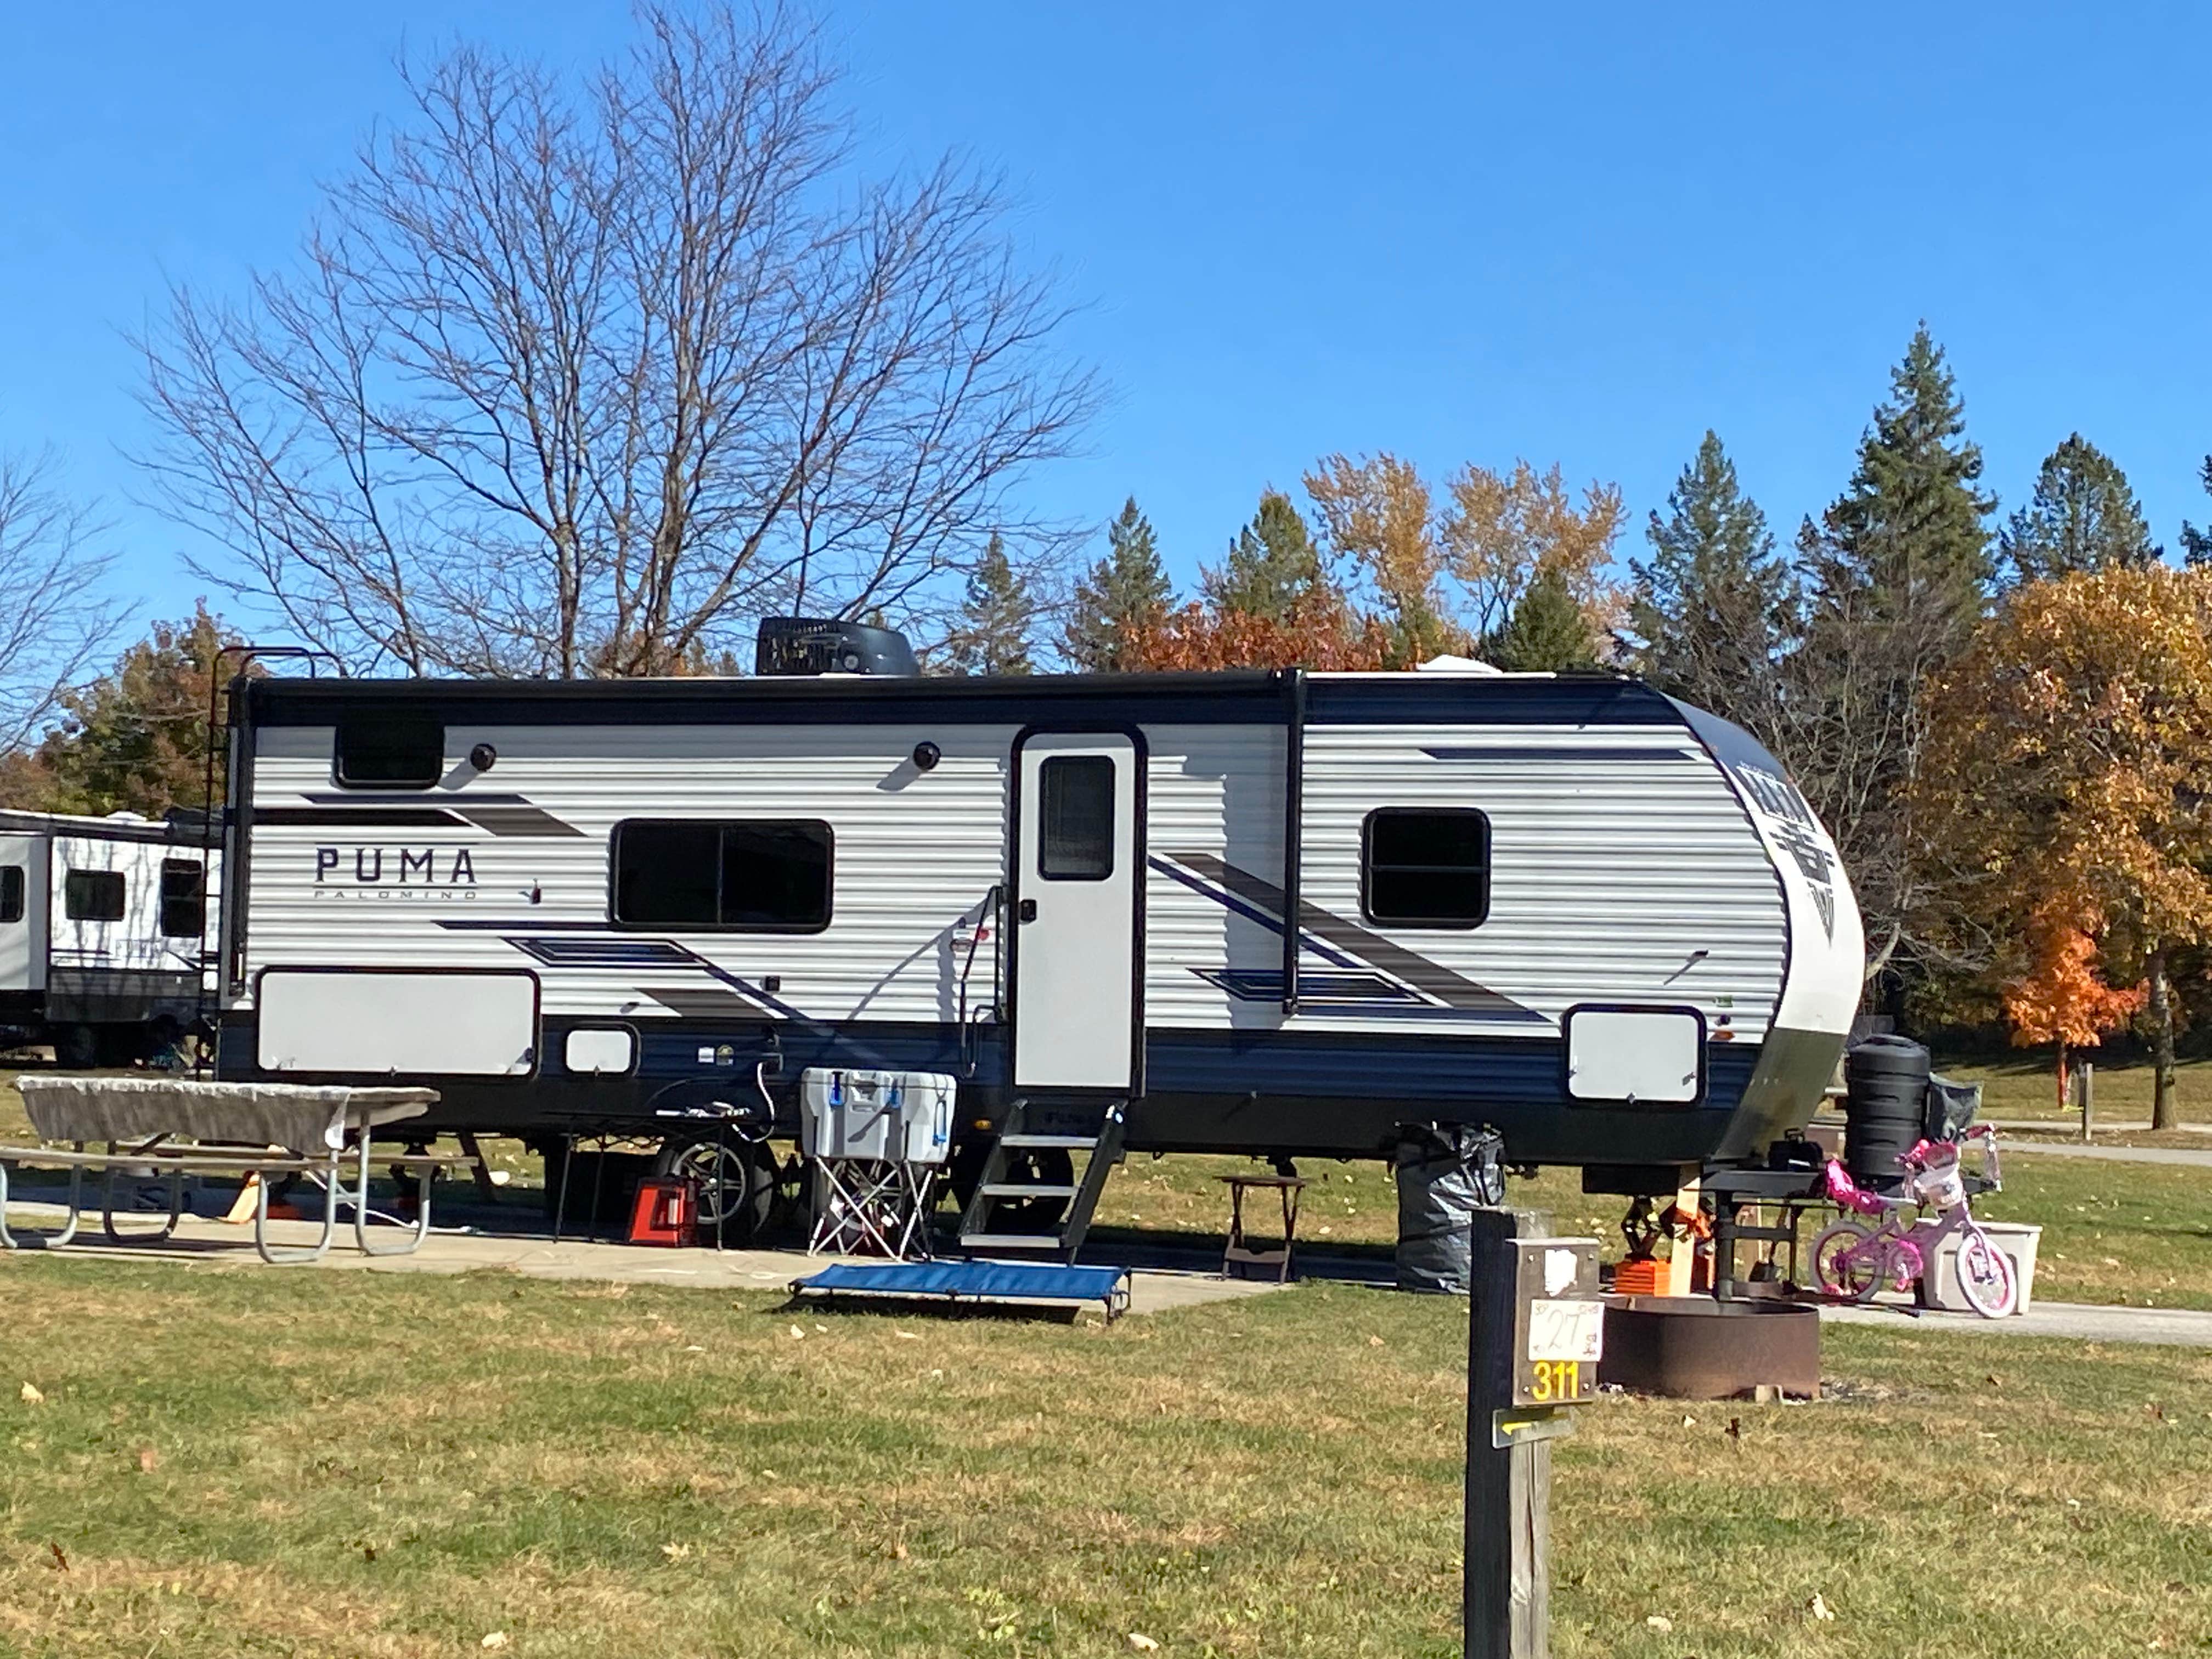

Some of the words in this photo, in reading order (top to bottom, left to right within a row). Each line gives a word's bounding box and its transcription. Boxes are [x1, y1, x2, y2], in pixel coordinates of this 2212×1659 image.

[315, 848, 477, 883] PUMA
[314, 890, 476, 900] PALOMINO
[1548, 1308, 1581, 1350] 27
[1532, 1360, 1579, 1401] 311
